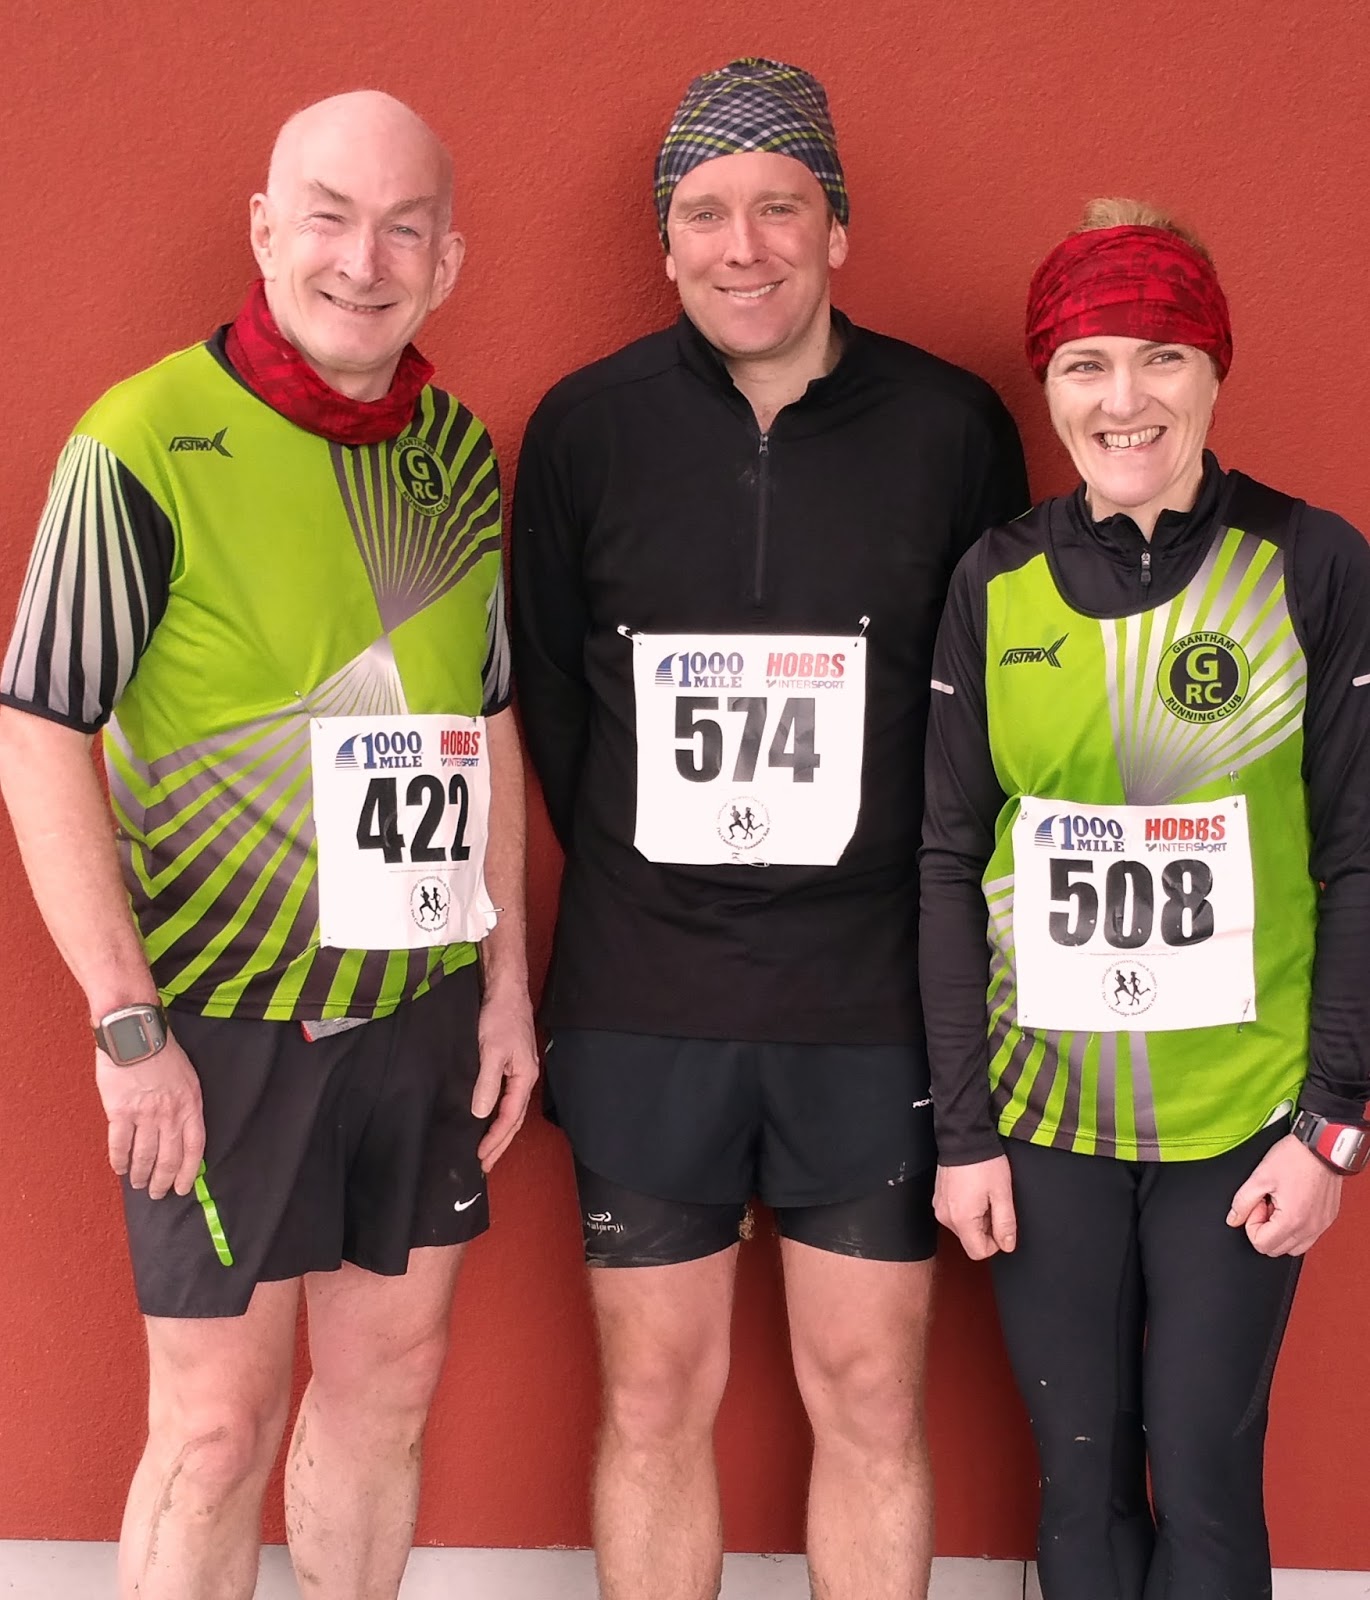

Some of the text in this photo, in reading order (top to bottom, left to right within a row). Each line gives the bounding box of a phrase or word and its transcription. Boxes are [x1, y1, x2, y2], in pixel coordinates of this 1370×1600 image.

[406, 449, 430, 480] G
[411, 480, 439, 500] RC
[1172, 633, 1236, 654] GRANTHAM
[678, 651, 744, 688] 1000
[765, 652, 846, 678] HOBBS
[1185, 646, 1219, 682] G
[693, 676, 743, 688] MILE
[778, 679, 845, 689] INTERSPORT
[1185, 682, 1222, 705] RC
[1165, 694, 1242, 721] RUNNING CLUB
[361, 730, 423, 770] 1000
[440, 730, 481, 756] HOBBS
[674, 695, 821, 783] 574
[379, 755, 423, 769] MILE
[356, 773, 471, 864] 422
[1144, 814, 1226, 842] HOBBS
[1058, 814, 1124, 851] 1000
[1076, 839, 1125, 853] MILE
[1048, 857, 1215, 950] 508
